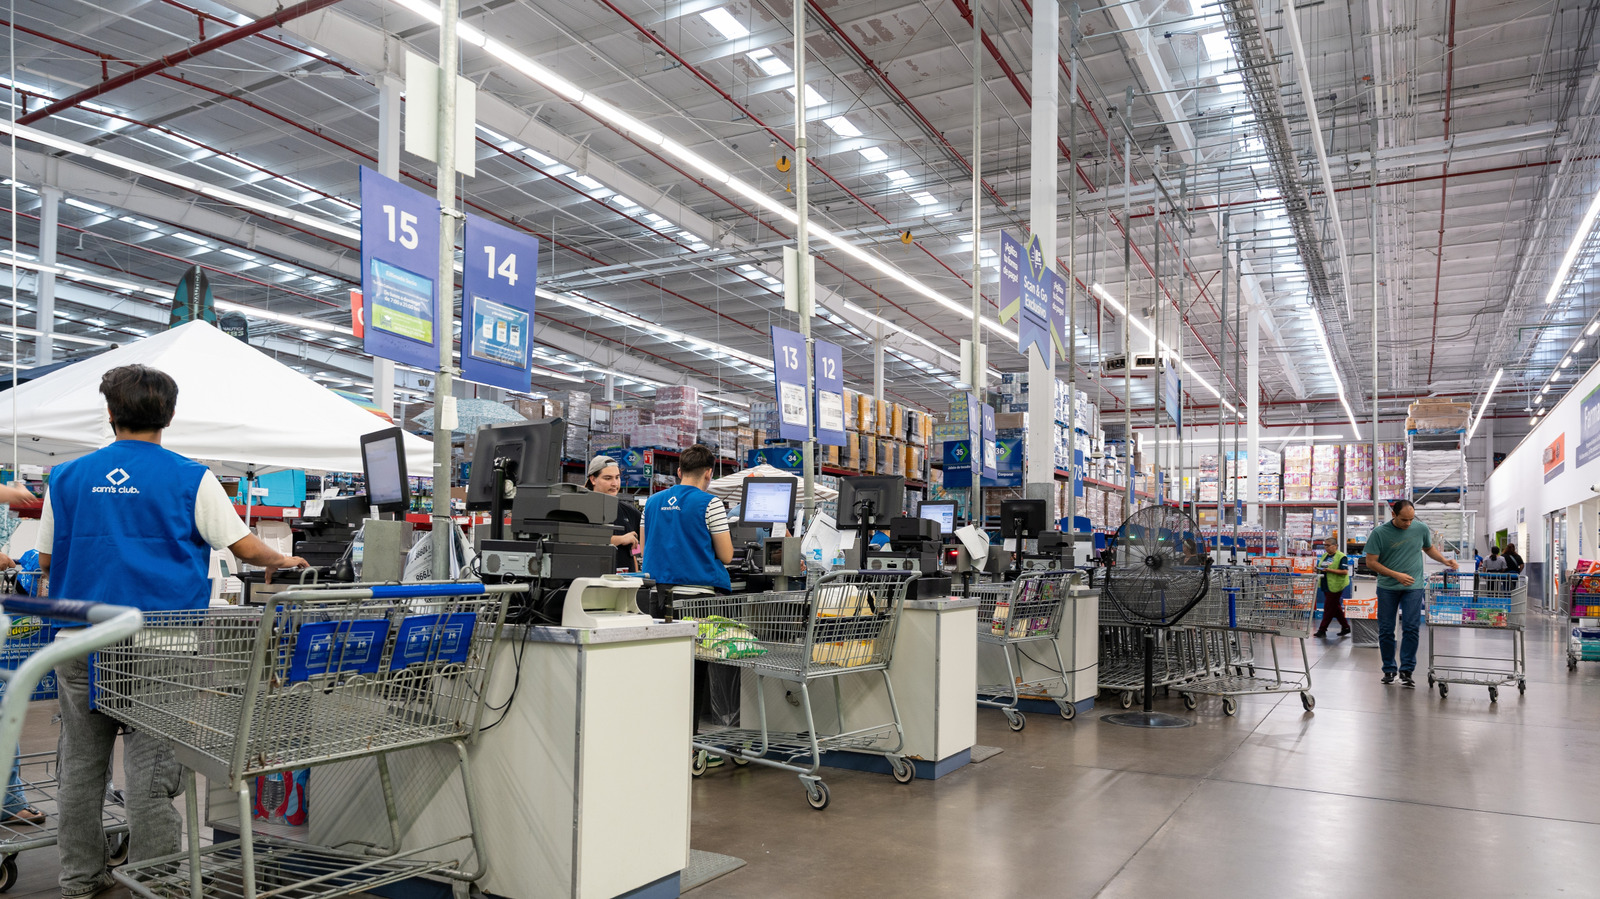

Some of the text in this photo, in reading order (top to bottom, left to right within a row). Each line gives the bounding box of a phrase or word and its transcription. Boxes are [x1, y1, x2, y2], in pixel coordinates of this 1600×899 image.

[382, 204, 418, 250] 15
[484, 246, 518, 286] 14
[1024, 275, 1048, 303] Scan & Go
[1025, 293, 1046, 319] Exclusivo
[782, 345, 799, 370] 13
[822, 357, 836, 380] 12
[985, 415, 993, 431] 10
[1074, 464, 1082, 481] 78
